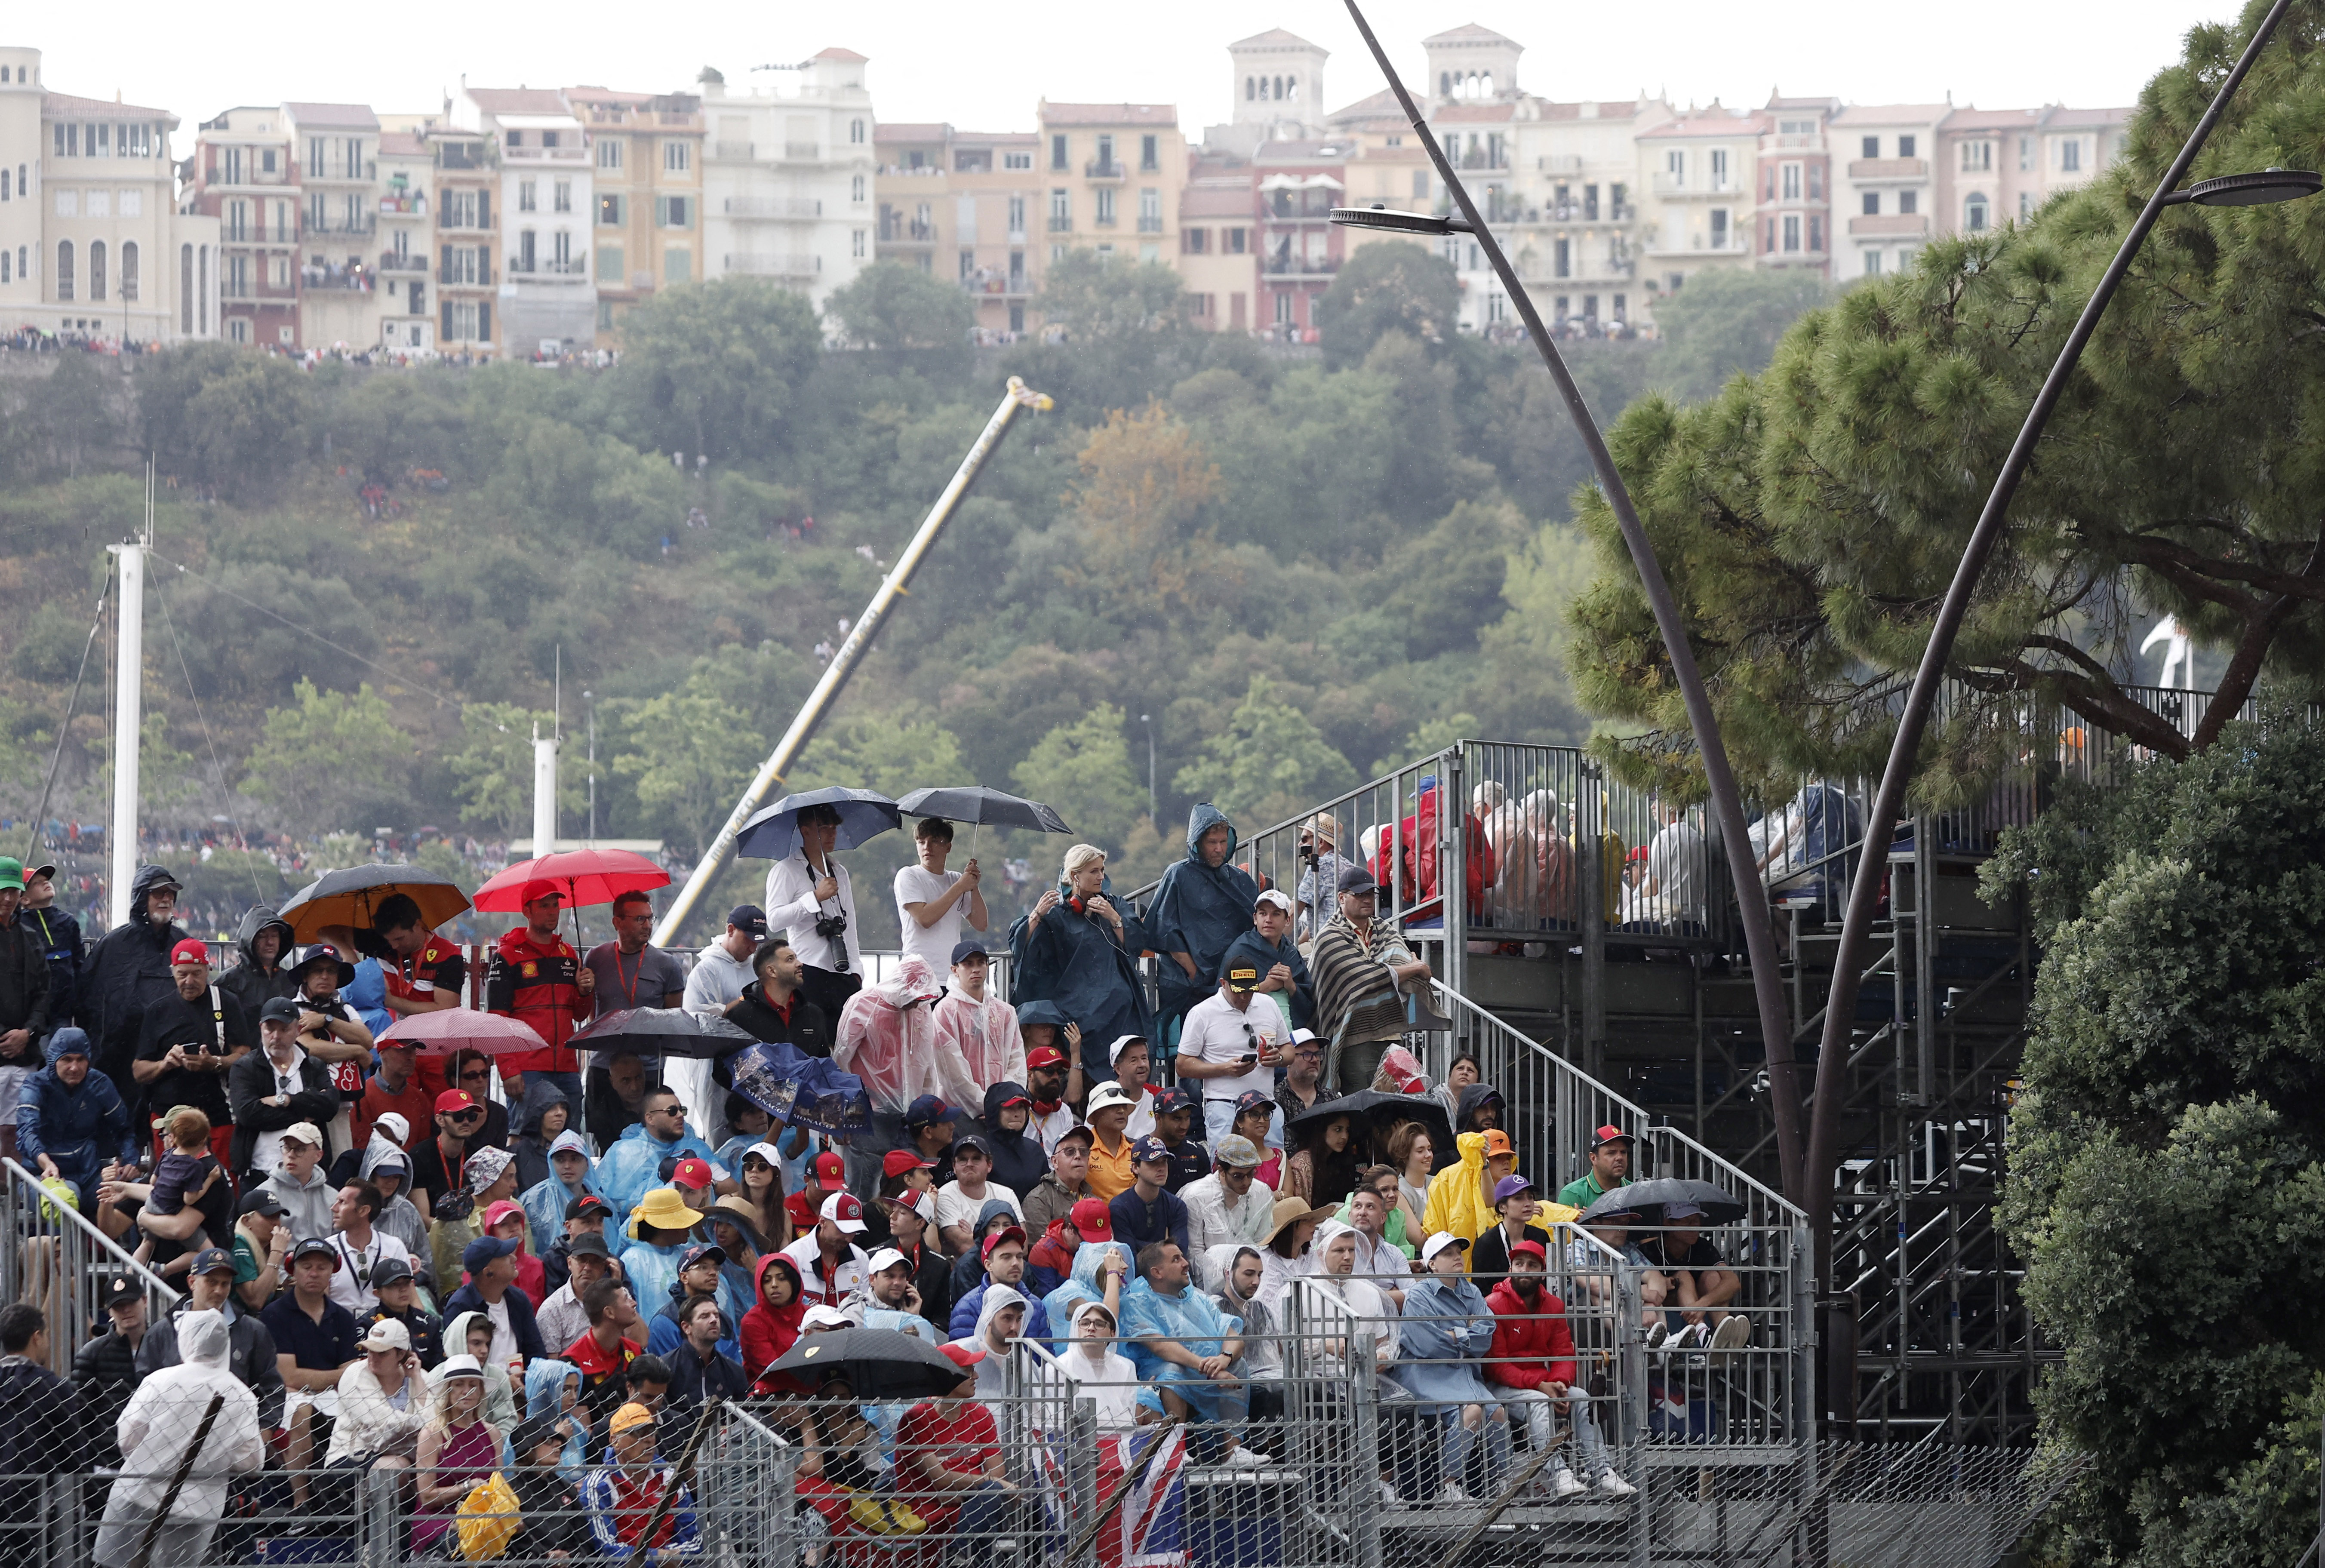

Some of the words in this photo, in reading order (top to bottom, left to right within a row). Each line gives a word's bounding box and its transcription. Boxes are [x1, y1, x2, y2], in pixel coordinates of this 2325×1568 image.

[711, 797, 755, 862] MEDIACO
[747, 1088, 784, 1113] MONACO
[793, 1113, 833, 1129] MONACO
